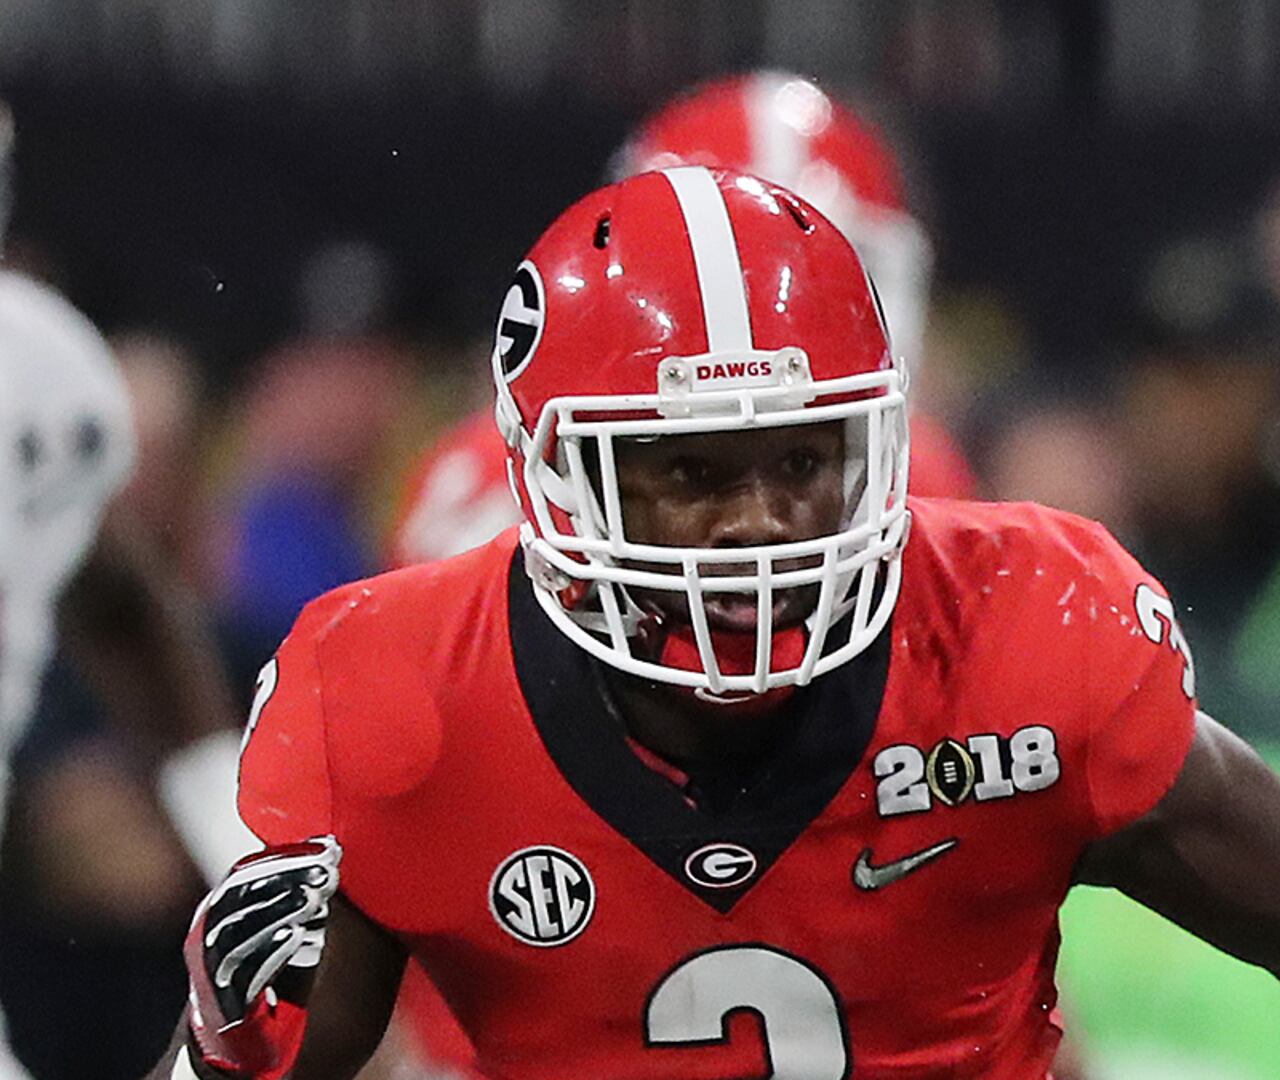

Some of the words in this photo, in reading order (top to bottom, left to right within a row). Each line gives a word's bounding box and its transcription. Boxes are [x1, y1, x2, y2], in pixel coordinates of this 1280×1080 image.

[697, 361, 772, 380] DAWGS
[686, 844, 756, 887] G
[496, 853, 587, 940] SEC
